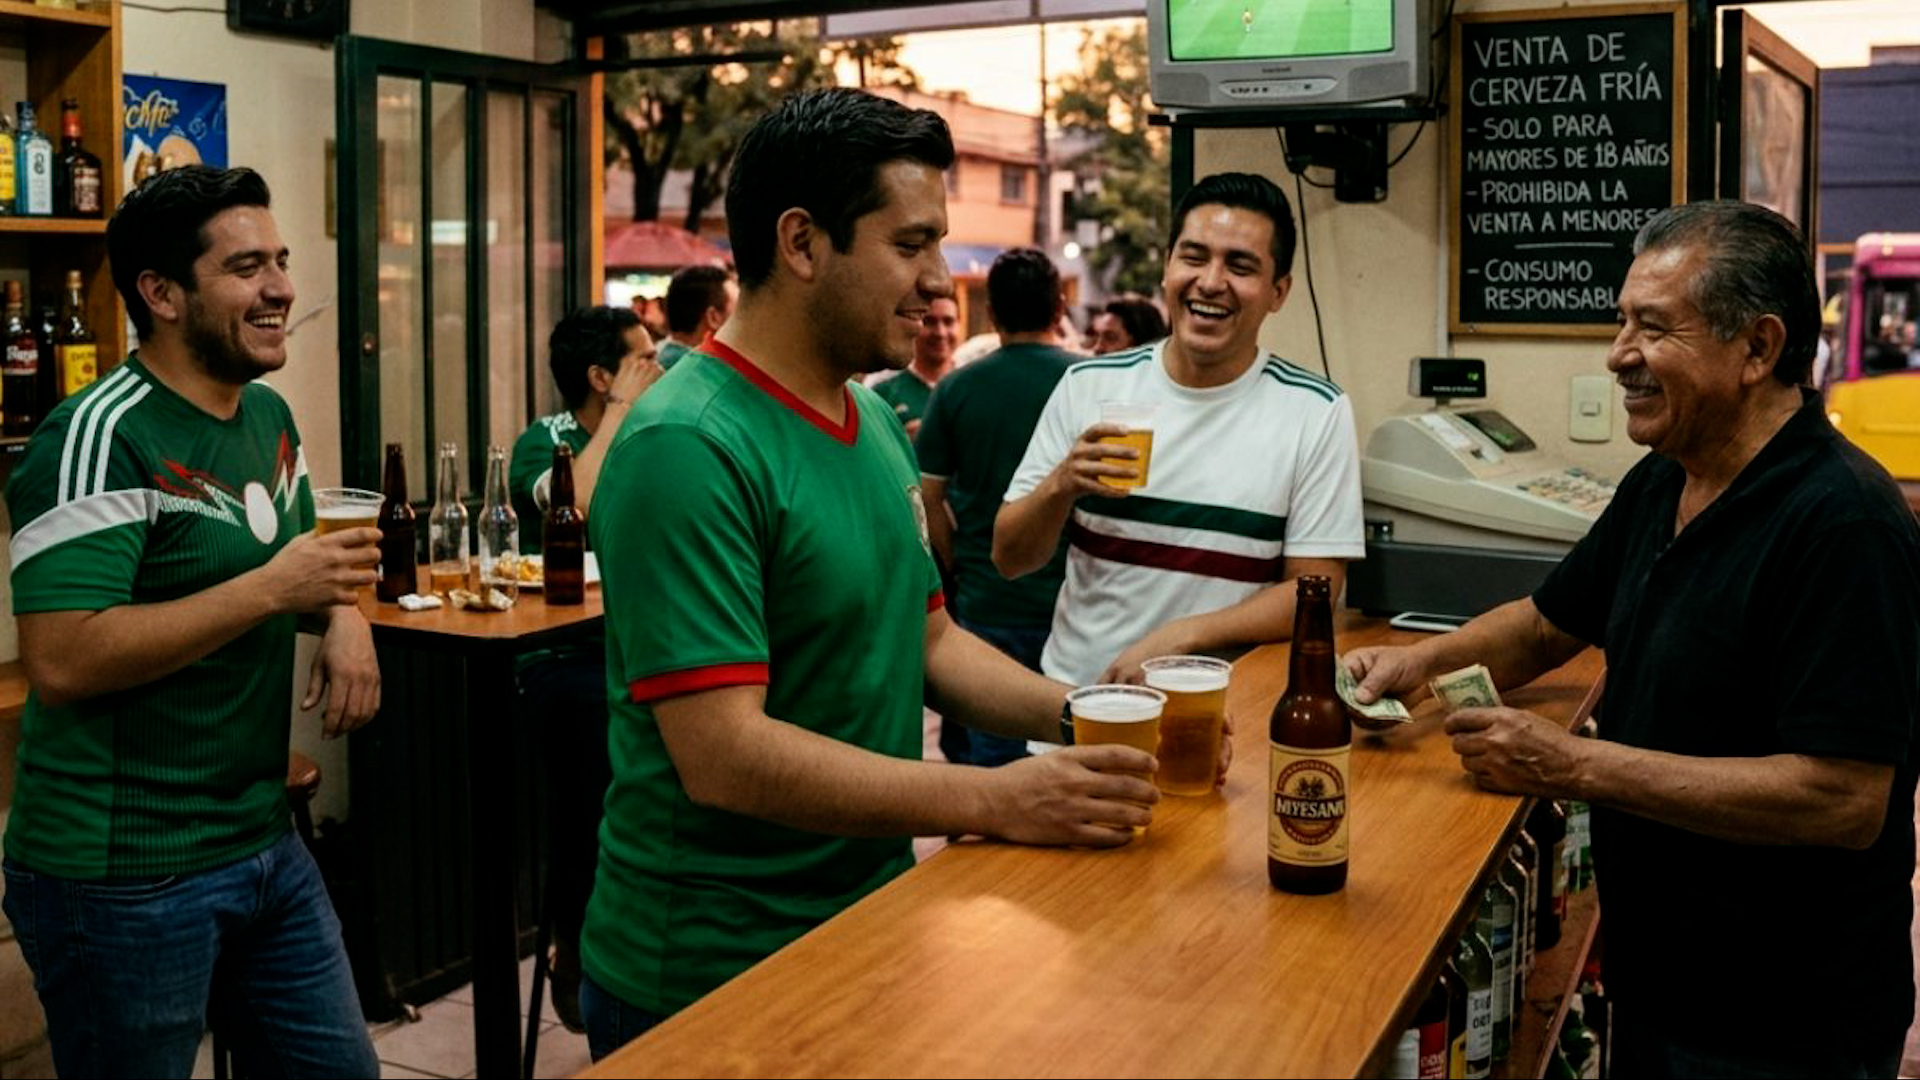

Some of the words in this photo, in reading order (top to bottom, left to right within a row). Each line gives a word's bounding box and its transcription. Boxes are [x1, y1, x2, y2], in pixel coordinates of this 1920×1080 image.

[1475, 36, 1568, 67] VENTA
[1587, 32, 1625, 62] DE
[1470, 75, 1586, 106] CERVEZA
[1600, 62, 1661, 100] FRÍA
[1484, 117, 1541, 139] SOLO
[1553, 114, 1613, 137] PARA
[1468, 148, 1557, 170] MAYORES
[1564, 147, 1587, 168] DE
[1595, 141, 1618, 168] 18
[1622, 139, 1669, 166] AÑOS
[1482, 180, 1591, 203] PROHIBIDA
[1601, 180, 1628, 201] LA
[1469, 212, 1533, 233] VENTA
[1541, 211, 1555, 232] A
[1485, 259, 1592, 282] CONSUMO
[1485, 287, 1619, 309] RESPONSABL
